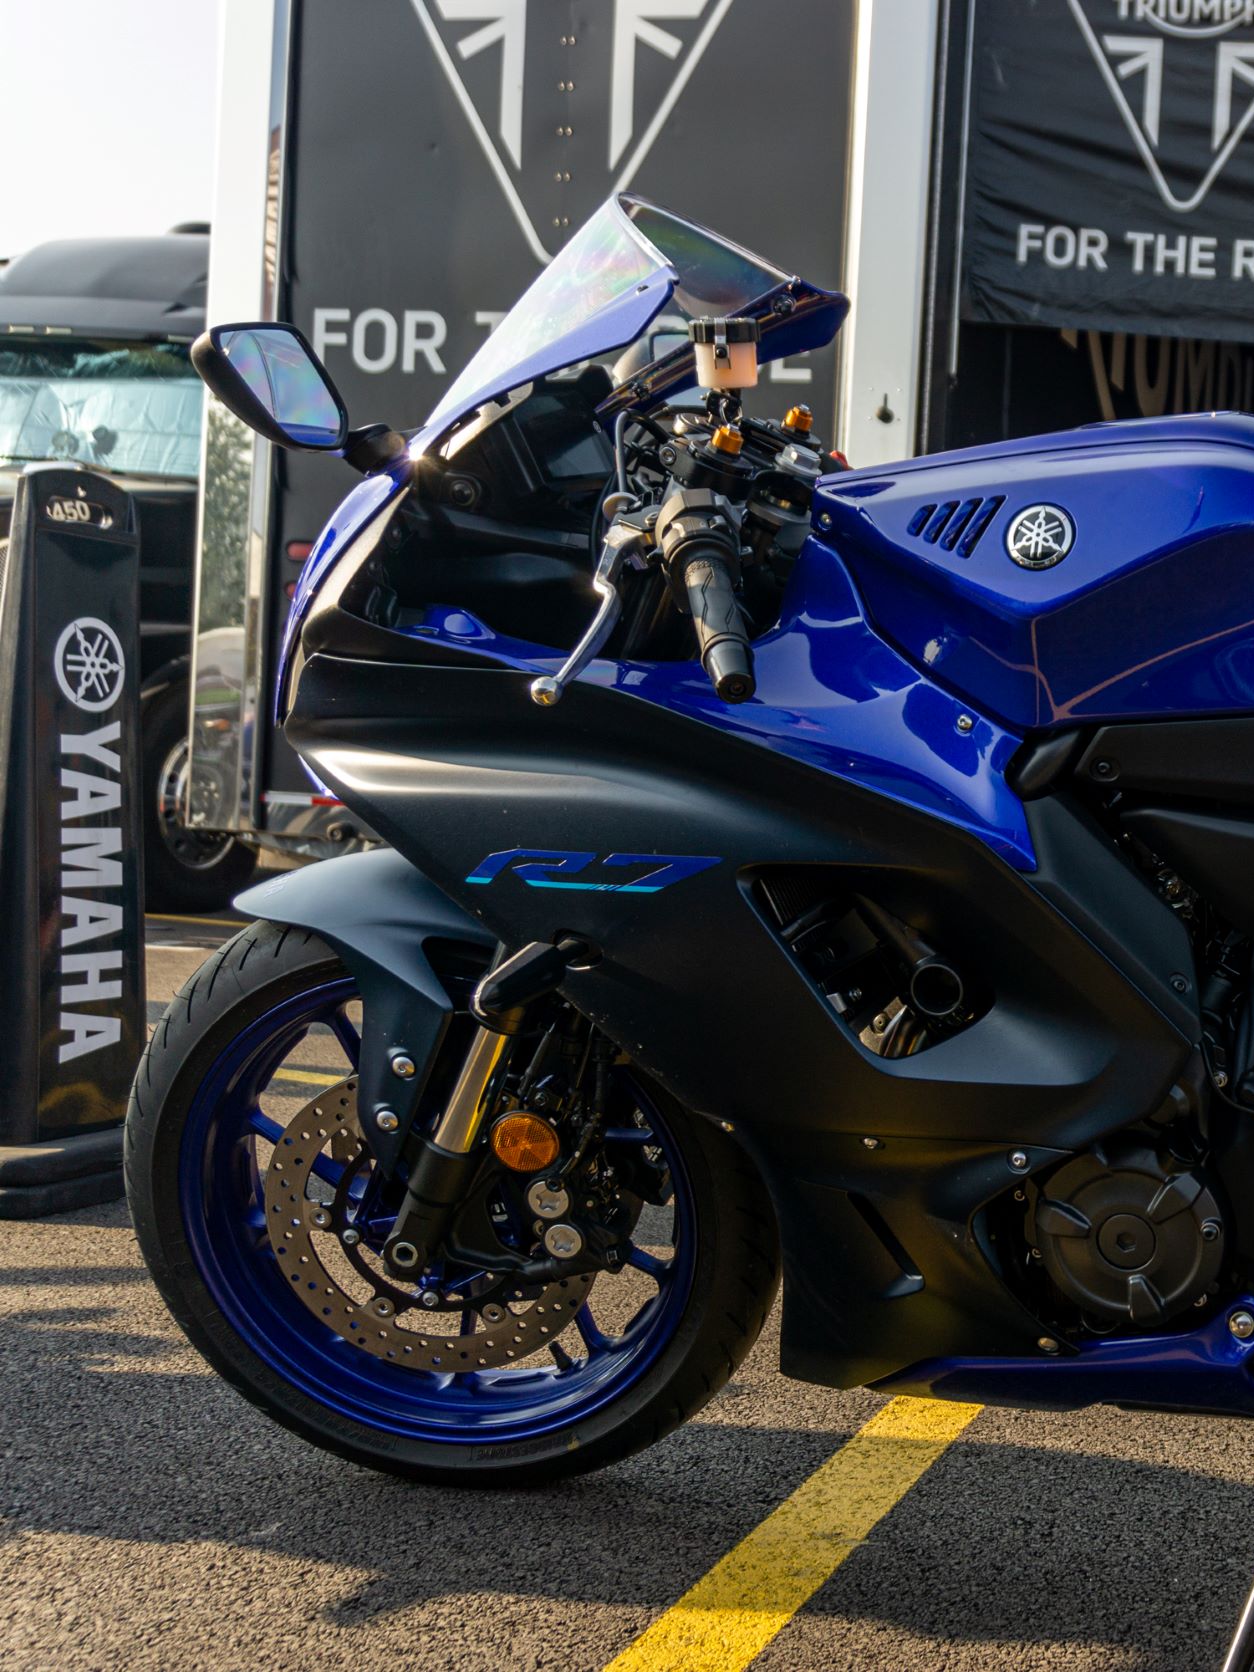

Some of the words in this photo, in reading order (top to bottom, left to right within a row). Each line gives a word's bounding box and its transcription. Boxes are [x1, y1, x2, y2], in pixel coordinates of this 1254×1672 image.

[1016, 223, 1109, 271] FOR
[1126, 231, 1218, 277] THE
[313, 308, 447, 373] FOR
[58, 719, 124, 1065] YAMAHA
[464, 847, 725, 893] R7
